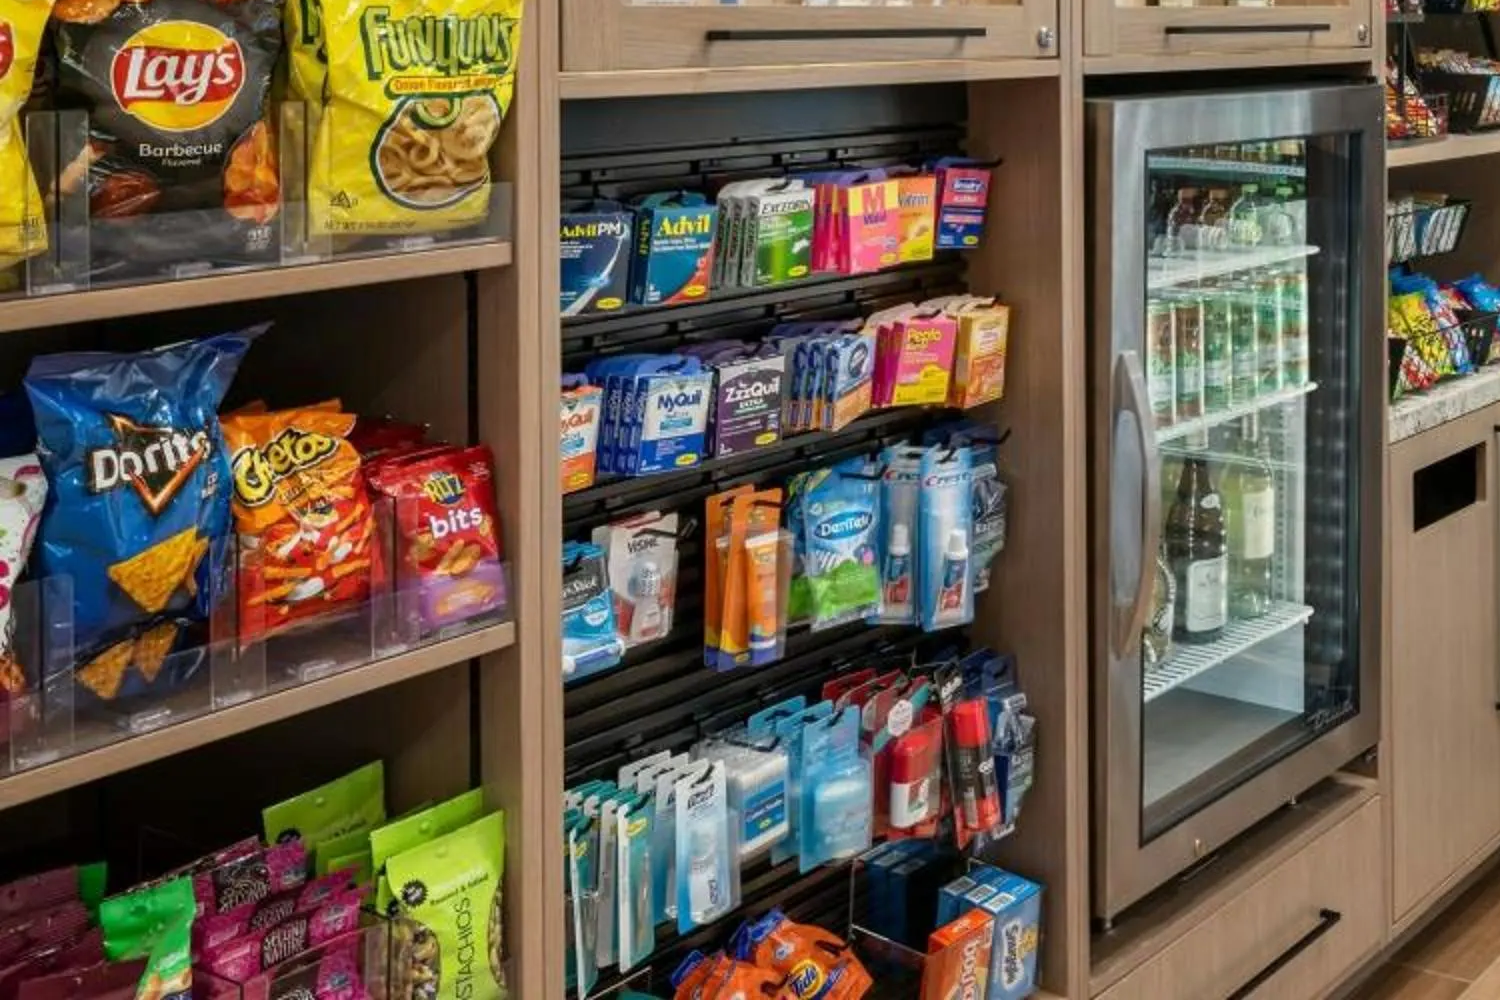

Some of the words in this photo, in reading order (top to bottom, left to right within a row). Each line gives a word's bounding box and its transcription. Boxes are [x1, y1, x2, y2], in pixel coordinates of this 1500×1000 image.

[123, 42, 236, 105] Lay's
[139, 143, 224, 158] Barbecue
[560, 222, 597, 238] Advil
[597, 219, 621, 237] PM
[657, 213, 711, 238] Advil
[657, 389, 702, 412] NyQuil
[560, 408, 593, 433] yQuil
[92, 431, 211, 490] Doritos
[423, 473, 467, 504] RITZ
[925, 471, 969, 487] Crest
[429, 507, 483, 539] bits
[455, 897, 475, 1000] ISTACHIOS
[792, 966, 818, 994] Tide
